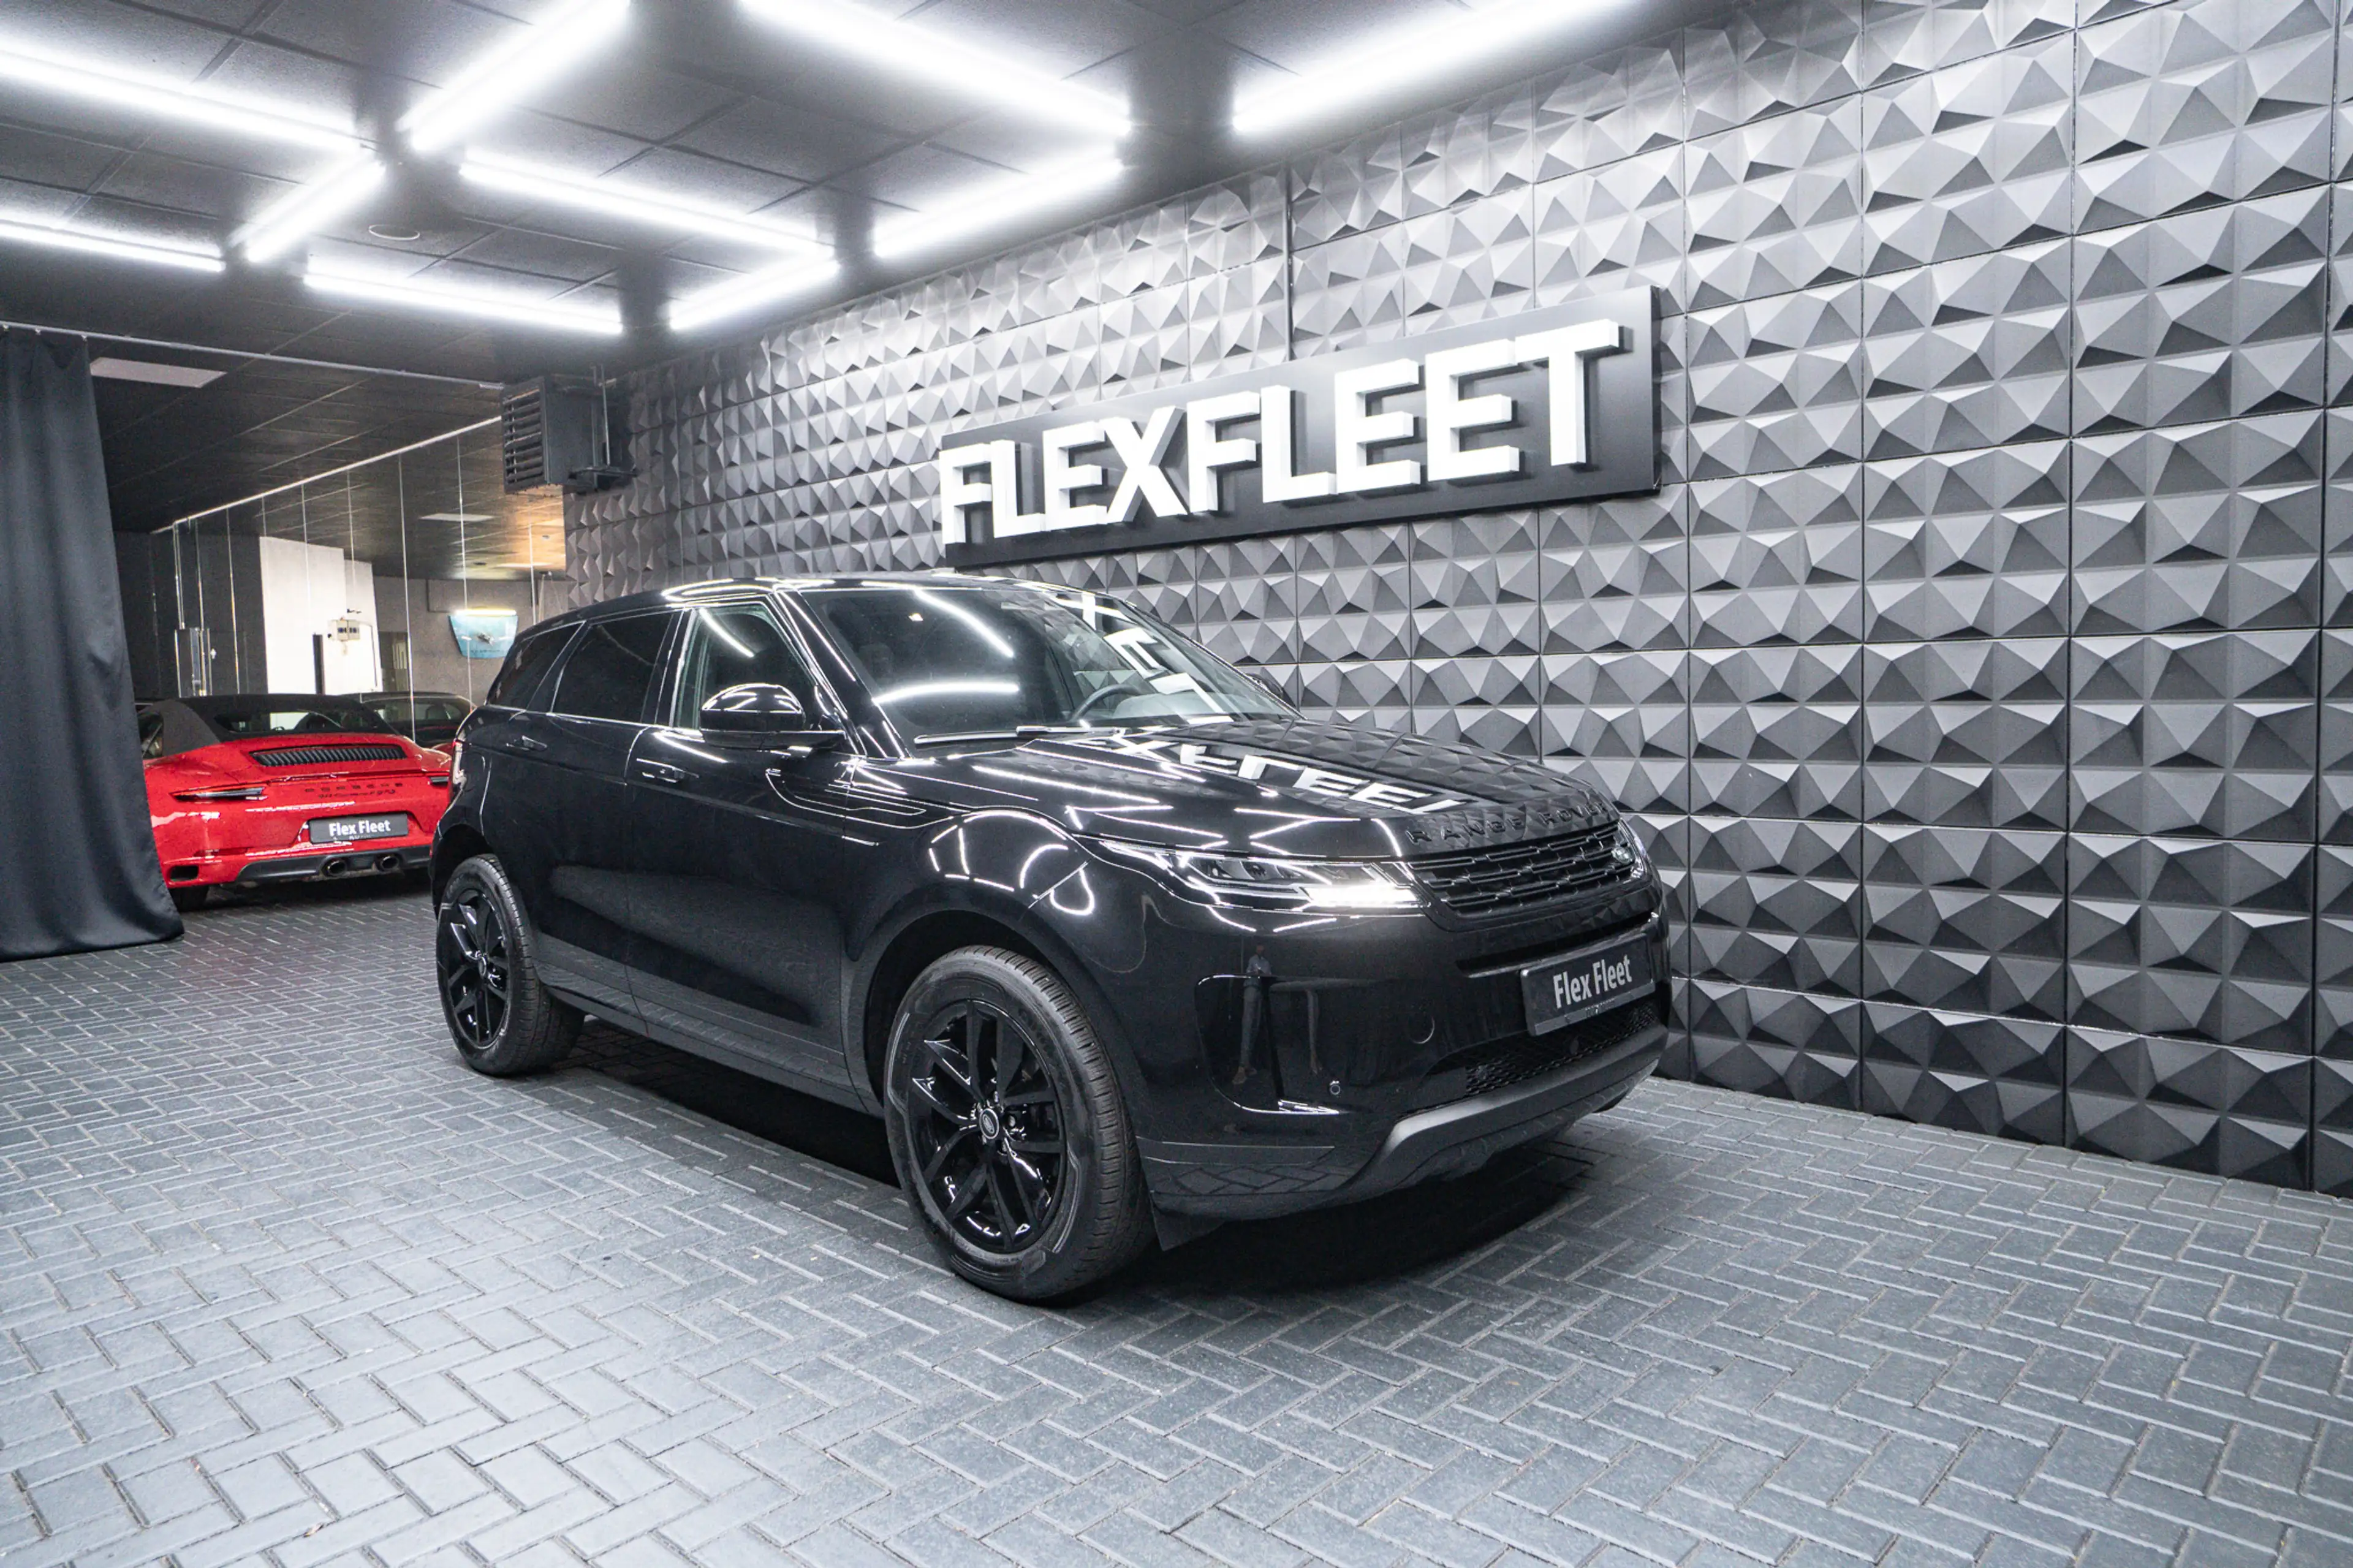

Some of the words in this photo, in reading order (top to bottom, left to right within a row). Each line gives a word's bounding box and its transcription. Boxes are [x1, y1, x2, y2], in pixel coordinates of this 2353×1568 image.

[939, 318, 1620, 544] FLEXFLEET
[328, 822, 357, 837] Flex
[358, 819, 391, 834] Fleet
[1405, 817, 1525, 845] RANGE
[1537, 801, 1608, 826] ROVER
[1553, 971, 1593, 1009] Flex
[1592, 953, 1632, 994] Fleet
